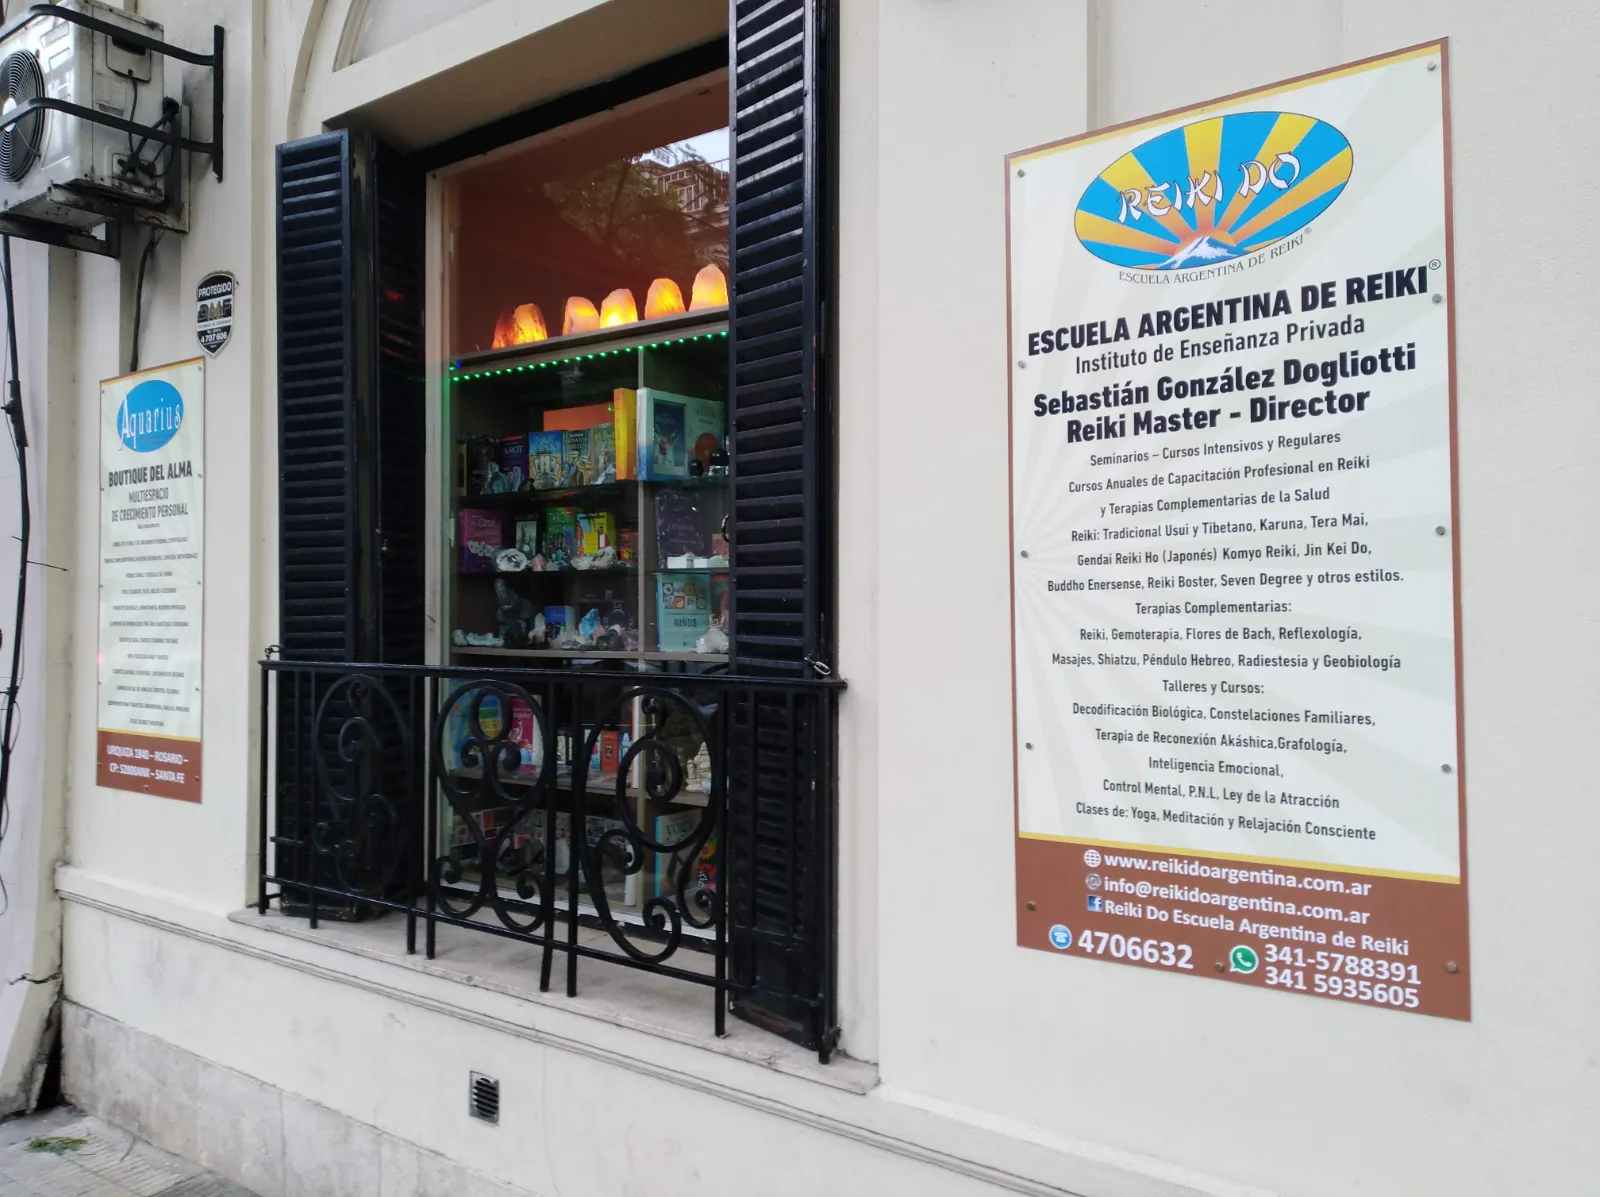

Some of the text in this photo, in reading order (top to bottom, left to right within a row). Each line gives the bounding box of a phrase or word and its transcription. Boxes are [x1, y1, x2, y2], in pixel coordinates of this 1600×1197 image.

[1117, 151, 1302, 224] REIKI DO
[1118, 270, 1171, 284] ESCUELA
[1173, 261, 1245, 284] ARGENTINA
[1247, 252, 1267, 268] DE
[198, 282, 232, 298] PROTEGIDO
[1028, 316, 1131, 356] ESCUELA
[1137, 288, 1292, 339] ARGENTINA
[1300, 280, 1337, 312] DE
[1075, 313, 1365, 375] Instituto de Enseñanza Privada
[1033, 342, 1417, 418] Sebastián González Dogliotti
[118, 390, 181, 451] Aquarius
[1066, 411, 1127, 444] Reiki
[1133, 402, 1221, 438] Master
[1250, 387, 1371, 425] Director
[1090, 450, 1149, 467] Seminarios
[1162, 447, 1200, 460] Cursos
[1203, 438, 1264, 456] Intensivos
[1267, 439, 1274, 452] y
[1278, 432, 1341, 450] Regulares
[108, 460, 193, 488] BOUTIQUE DEL ALMA
[1069, 455, 1371, 493] Cursos Anuales de Capacitación Profesional en Reiki
[128, 487, 169, 504] MULTIESPACIO
[1100, 486, 1330, 518] y Terapias Complementarias de la Salud
[111, 502, 189, 523] DE CRECIMIENTO PERSONAL
[1071, 512, 1369, 542] Reiki: Tradicional Usui y Tibetano, Karuna, Tera Mai,
[1077, 541, 1372, 566] Gendai Reiki Ho (Japonés) Komyo Reiki, Jin Kei Do,
[1047, 568, 1404, 592] Buddho Enersense, Reiki Boster, Seven Degree y otros estilos.
[673, 616, 698, 629] NIÑOS
[1135, 600, 1292, 617] Terapias Complementarias:
[1080, 625, 1362, 643] Reiki, Gemoterapia, Flores de Bach, Reflexología,
[1052, 653, 1401, 672] Masajes, Shiatzu, Péndulo Hebreo, Radiestesia y Geobiología
[1162, 680, 1265, 696] Talleres y Cursos:
[1072, 702, 1376, 726] Decodificación Biológica, Constelaciones Familiares,
[1095, 728, 1134, 744] Terapia
[1136, 730, 1150, 743] de
[1153, 731, 1217, 747] Reconexión
[176, 772, 185, 784] FE
[1149, 756, 1284, 778] Inteligencia Emocional,
[1103, 779, 1142, 794] Control
[1144, 781, 1185, 798] Mental,
[1223, 788, 1243, 804] Ley
[1246, 789, 1261, 803] de
[1264, 790, 1276, 804] la
[1280, 791, 1340, 809] Atracción
[1076, 801, 1377, 841] Clases de: Yoga, Meditación y Relajación Consciente
[1104, 854, 1372, 897] www.reikidoargentina.com.ar
[1104, 876, 1371, 925] info@reikidoargentina.com.ar
[1105, 900, 1142, 919] Reiki
[1146, 906, 1169, 922] Do
[1173, 908, 1235, 931] Escuela
[1239, 918, 1327, 945] Argentina
[1332, 931, 1356, 949] de
[1361, 934, 1409, 956] Reiki
[1078, 929, 1194, 970] 4706632
[1264, 943, 1422, 985] 341-5788391
[1265, 966, 1420, 1009] 341 5935605
